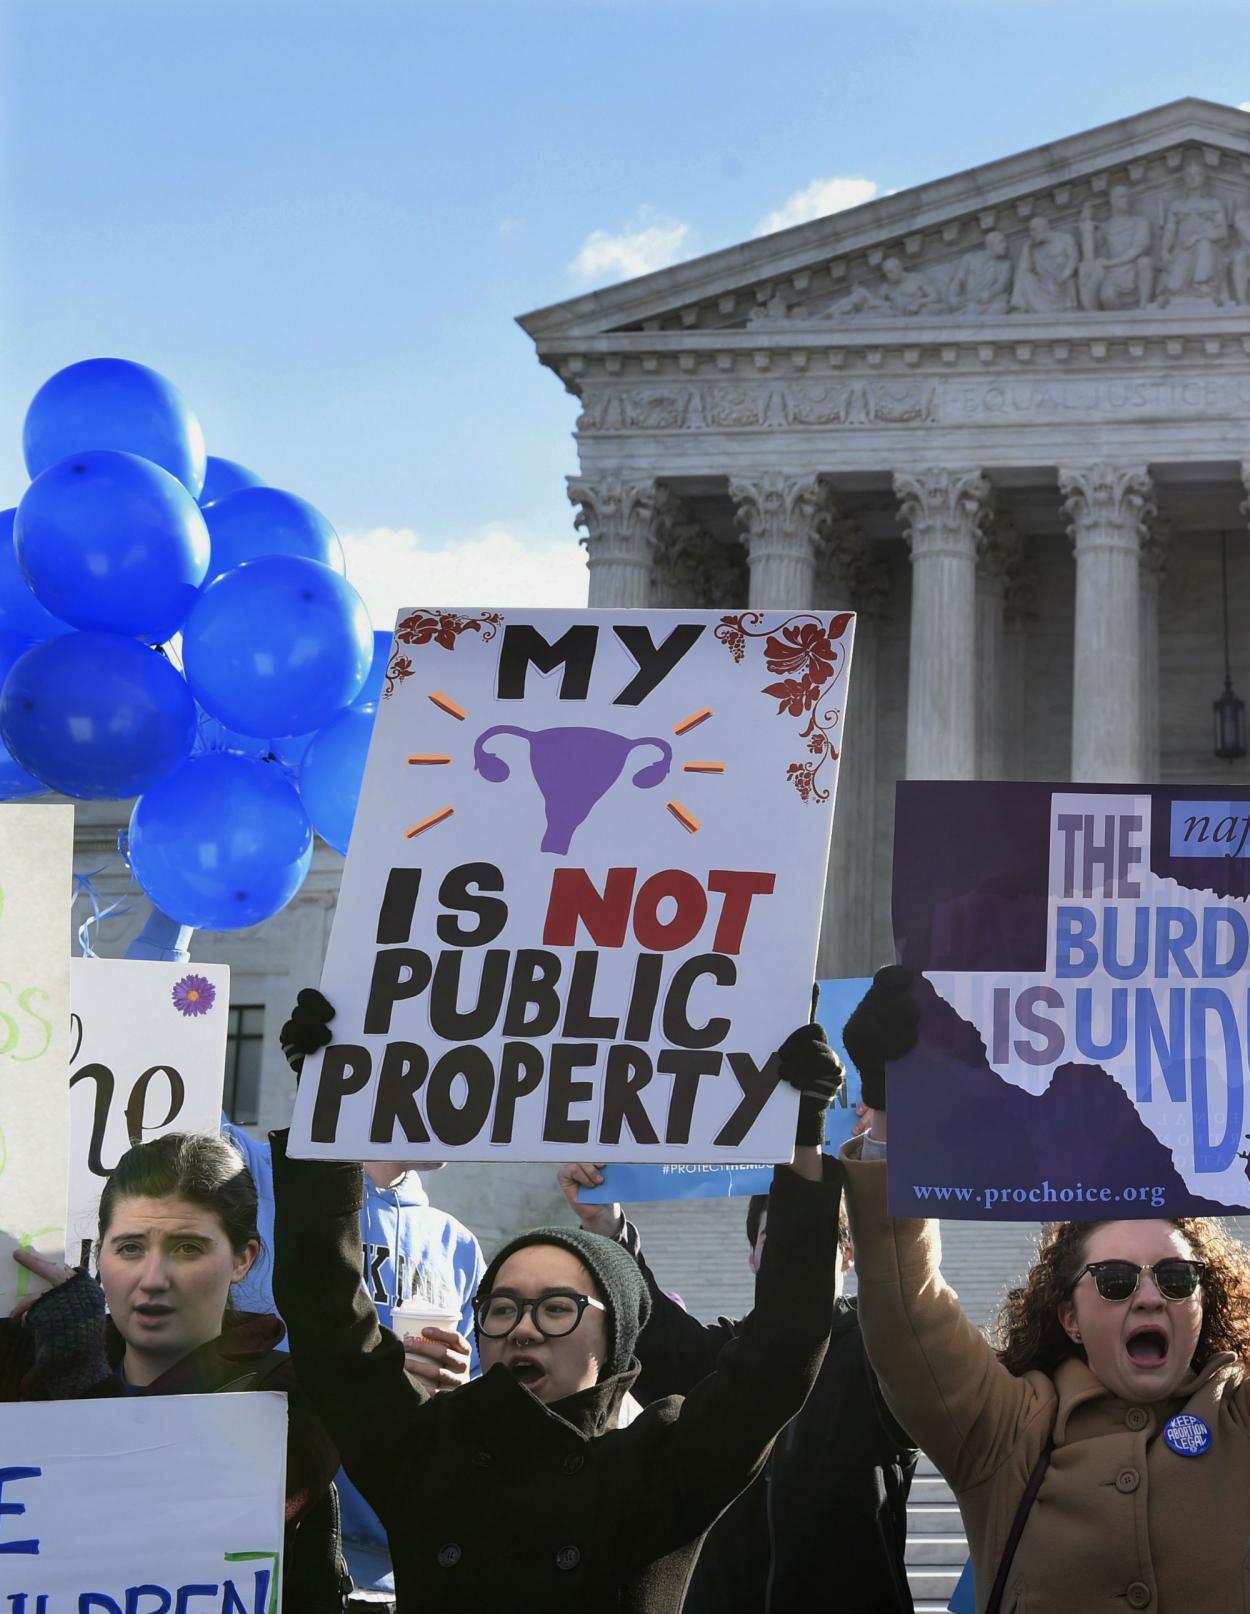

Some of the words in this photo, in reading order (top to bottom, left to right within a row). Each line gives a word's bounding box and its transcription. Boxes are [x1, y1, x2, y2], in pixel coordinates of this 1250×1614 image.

[496, 624, 707, 706] MY
[1057, 814, 1143, 899] THE
[376, 862, 509, 948] IS
[544, 869, 775, 954] NOT
[363, 948, 738, 1050] PUBLIC
[992, 987, 1065, 1066] IS
[311, 1041, 781, 1147] PROPERTY
[912, 1181, 1166, 1209] www.prochoice.org
[1167, 1424, 1208, 1441] ABORTION
[1171, 1415, 1197, 1428] KEEP
[1173, 1435, 1207, 1450] LEGAL
